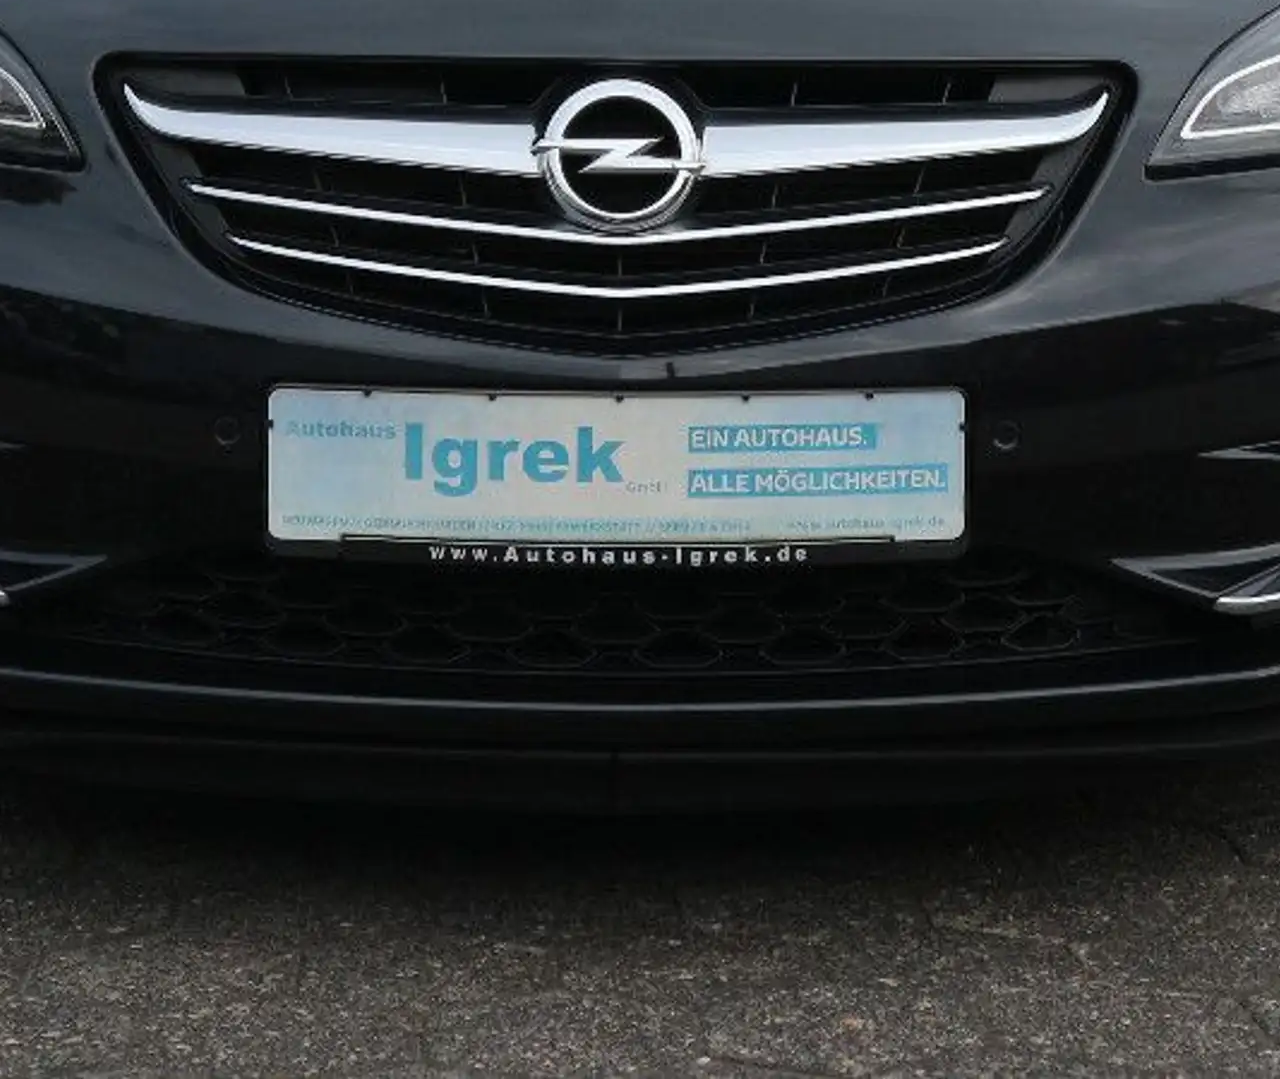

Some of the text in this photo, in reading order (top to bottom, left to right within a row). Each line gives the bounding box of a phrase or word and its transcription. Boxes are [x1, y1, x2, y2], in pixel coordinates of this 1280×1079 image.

[287, 421, 397, 439] Autohaus
[691, 426, 867, 449] EIN AUTOHAUS.
[404, 422, 626, 497] Igrek
[691, 469, 945, 493] ALLE MÖGLICHKEITEN.
[428, 546, 808, 566] www.Autohaus-Igrek.de
